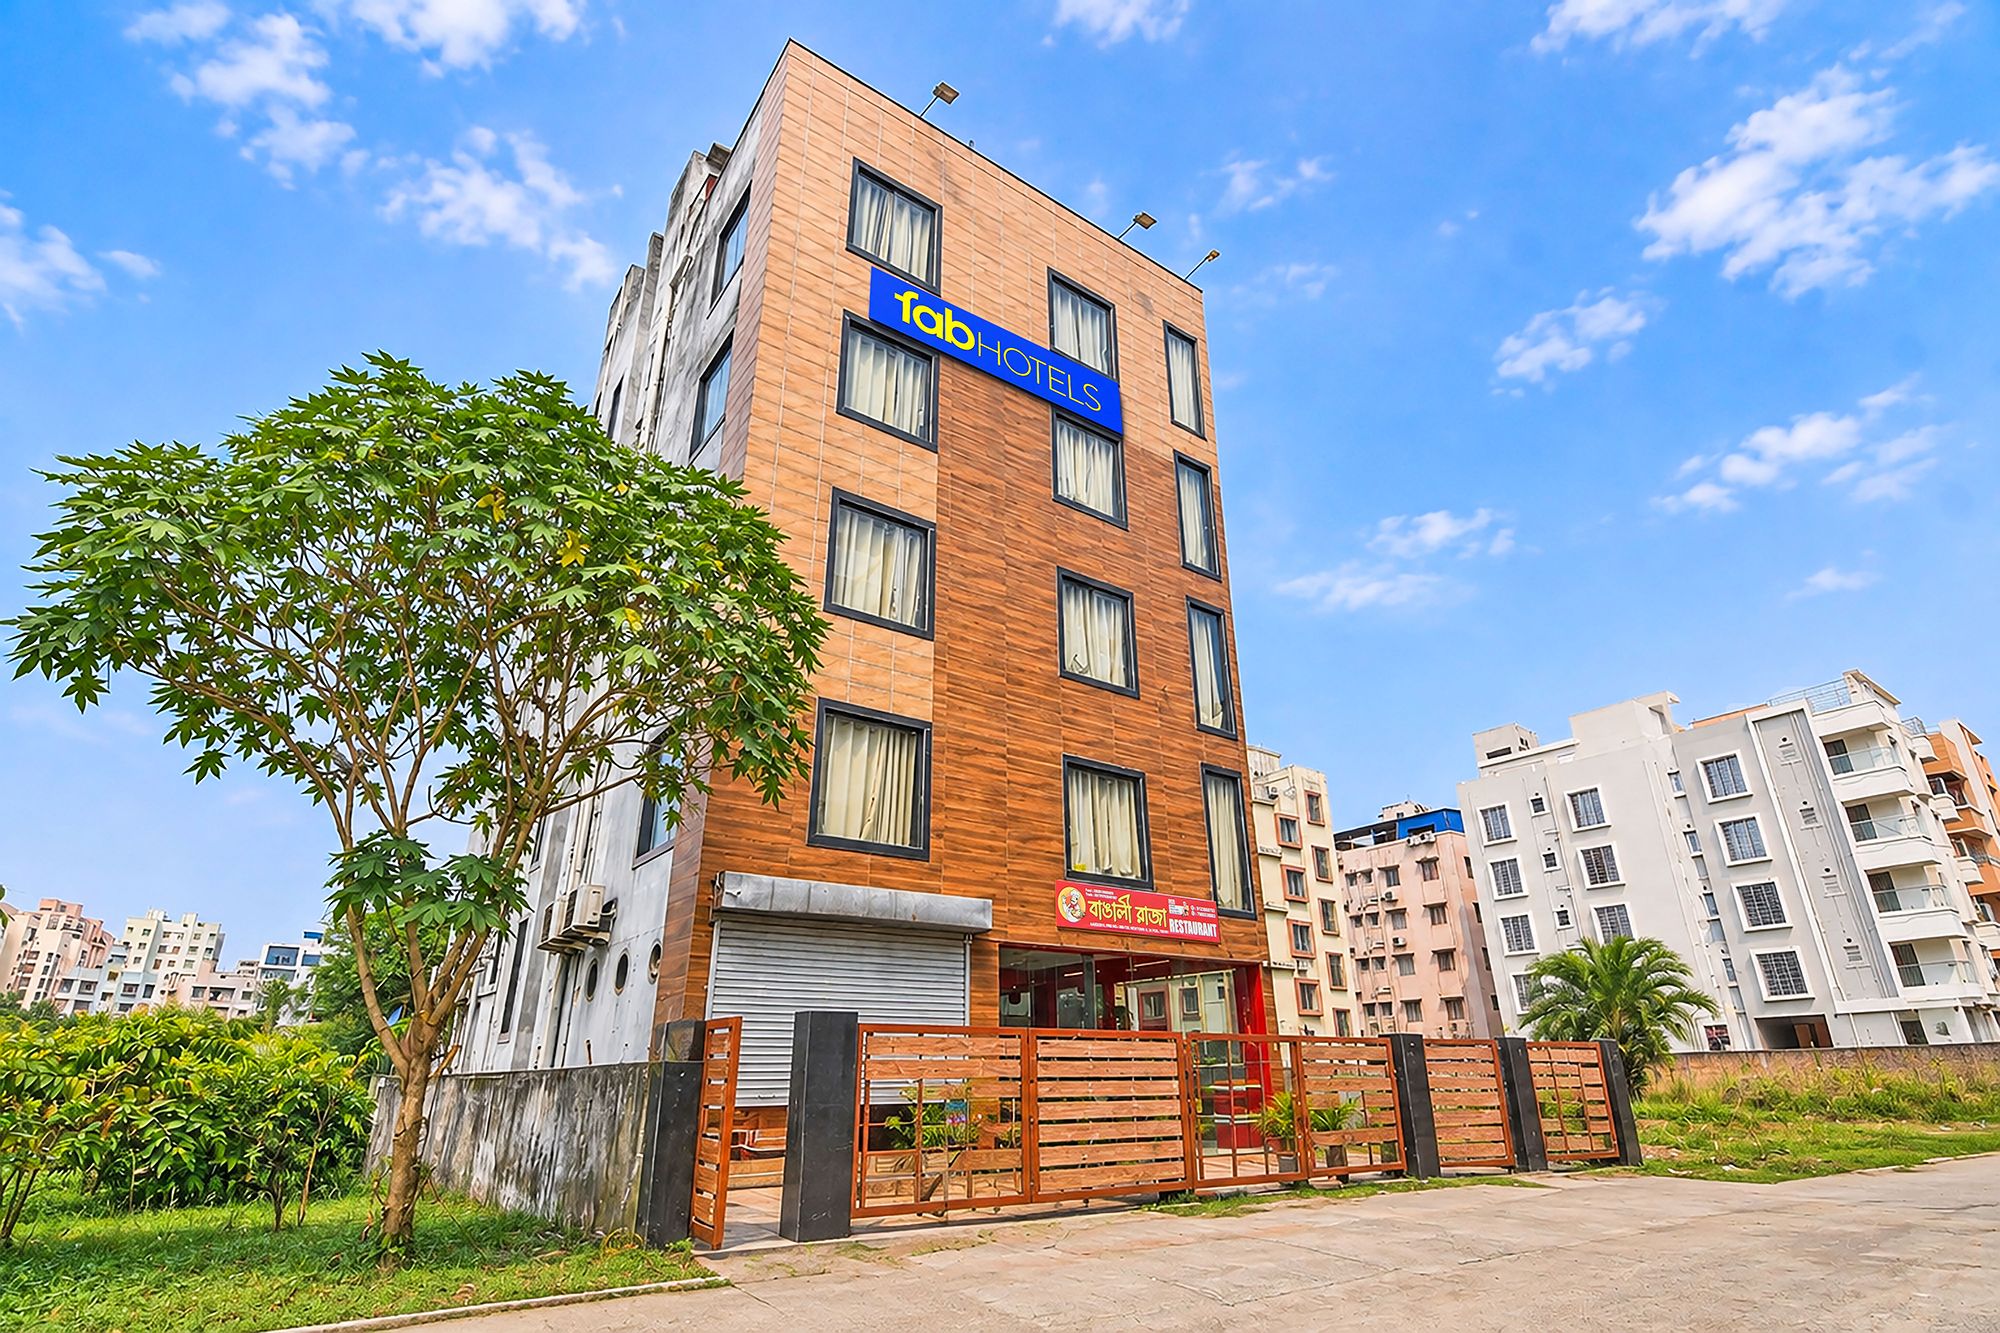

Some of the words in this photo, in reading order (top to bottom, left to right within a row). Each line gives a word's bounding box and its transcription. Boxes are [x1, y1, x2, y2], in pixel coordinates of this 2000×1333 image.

[1088, 894, 1132, 923] বাঙালী
[1135, 906, 1167, 927] রাজা
[1169, 919, 1216, 937] RESTAURANT
